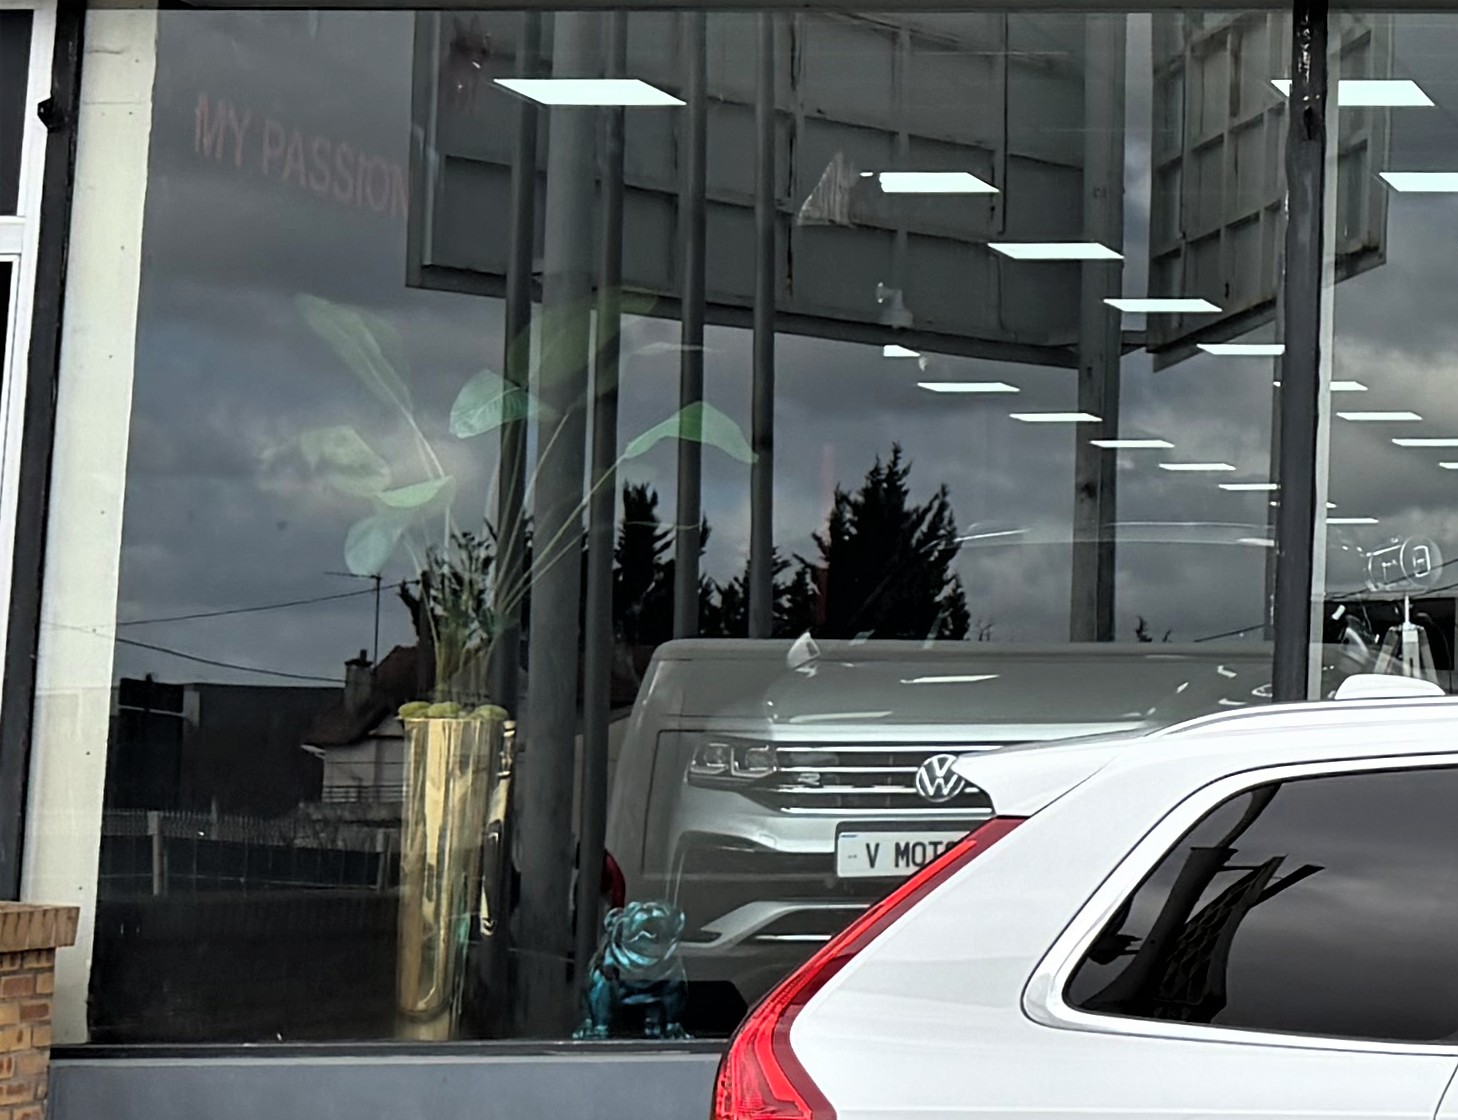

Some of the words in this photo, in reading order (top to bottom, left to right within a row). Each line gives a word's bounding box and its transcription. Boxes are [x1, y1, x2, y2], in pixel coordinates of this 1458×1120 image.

[195, 93, 252, 168] MY
[260, 115, 409, 220] PASSION
[865, 842, 880, 868] V
